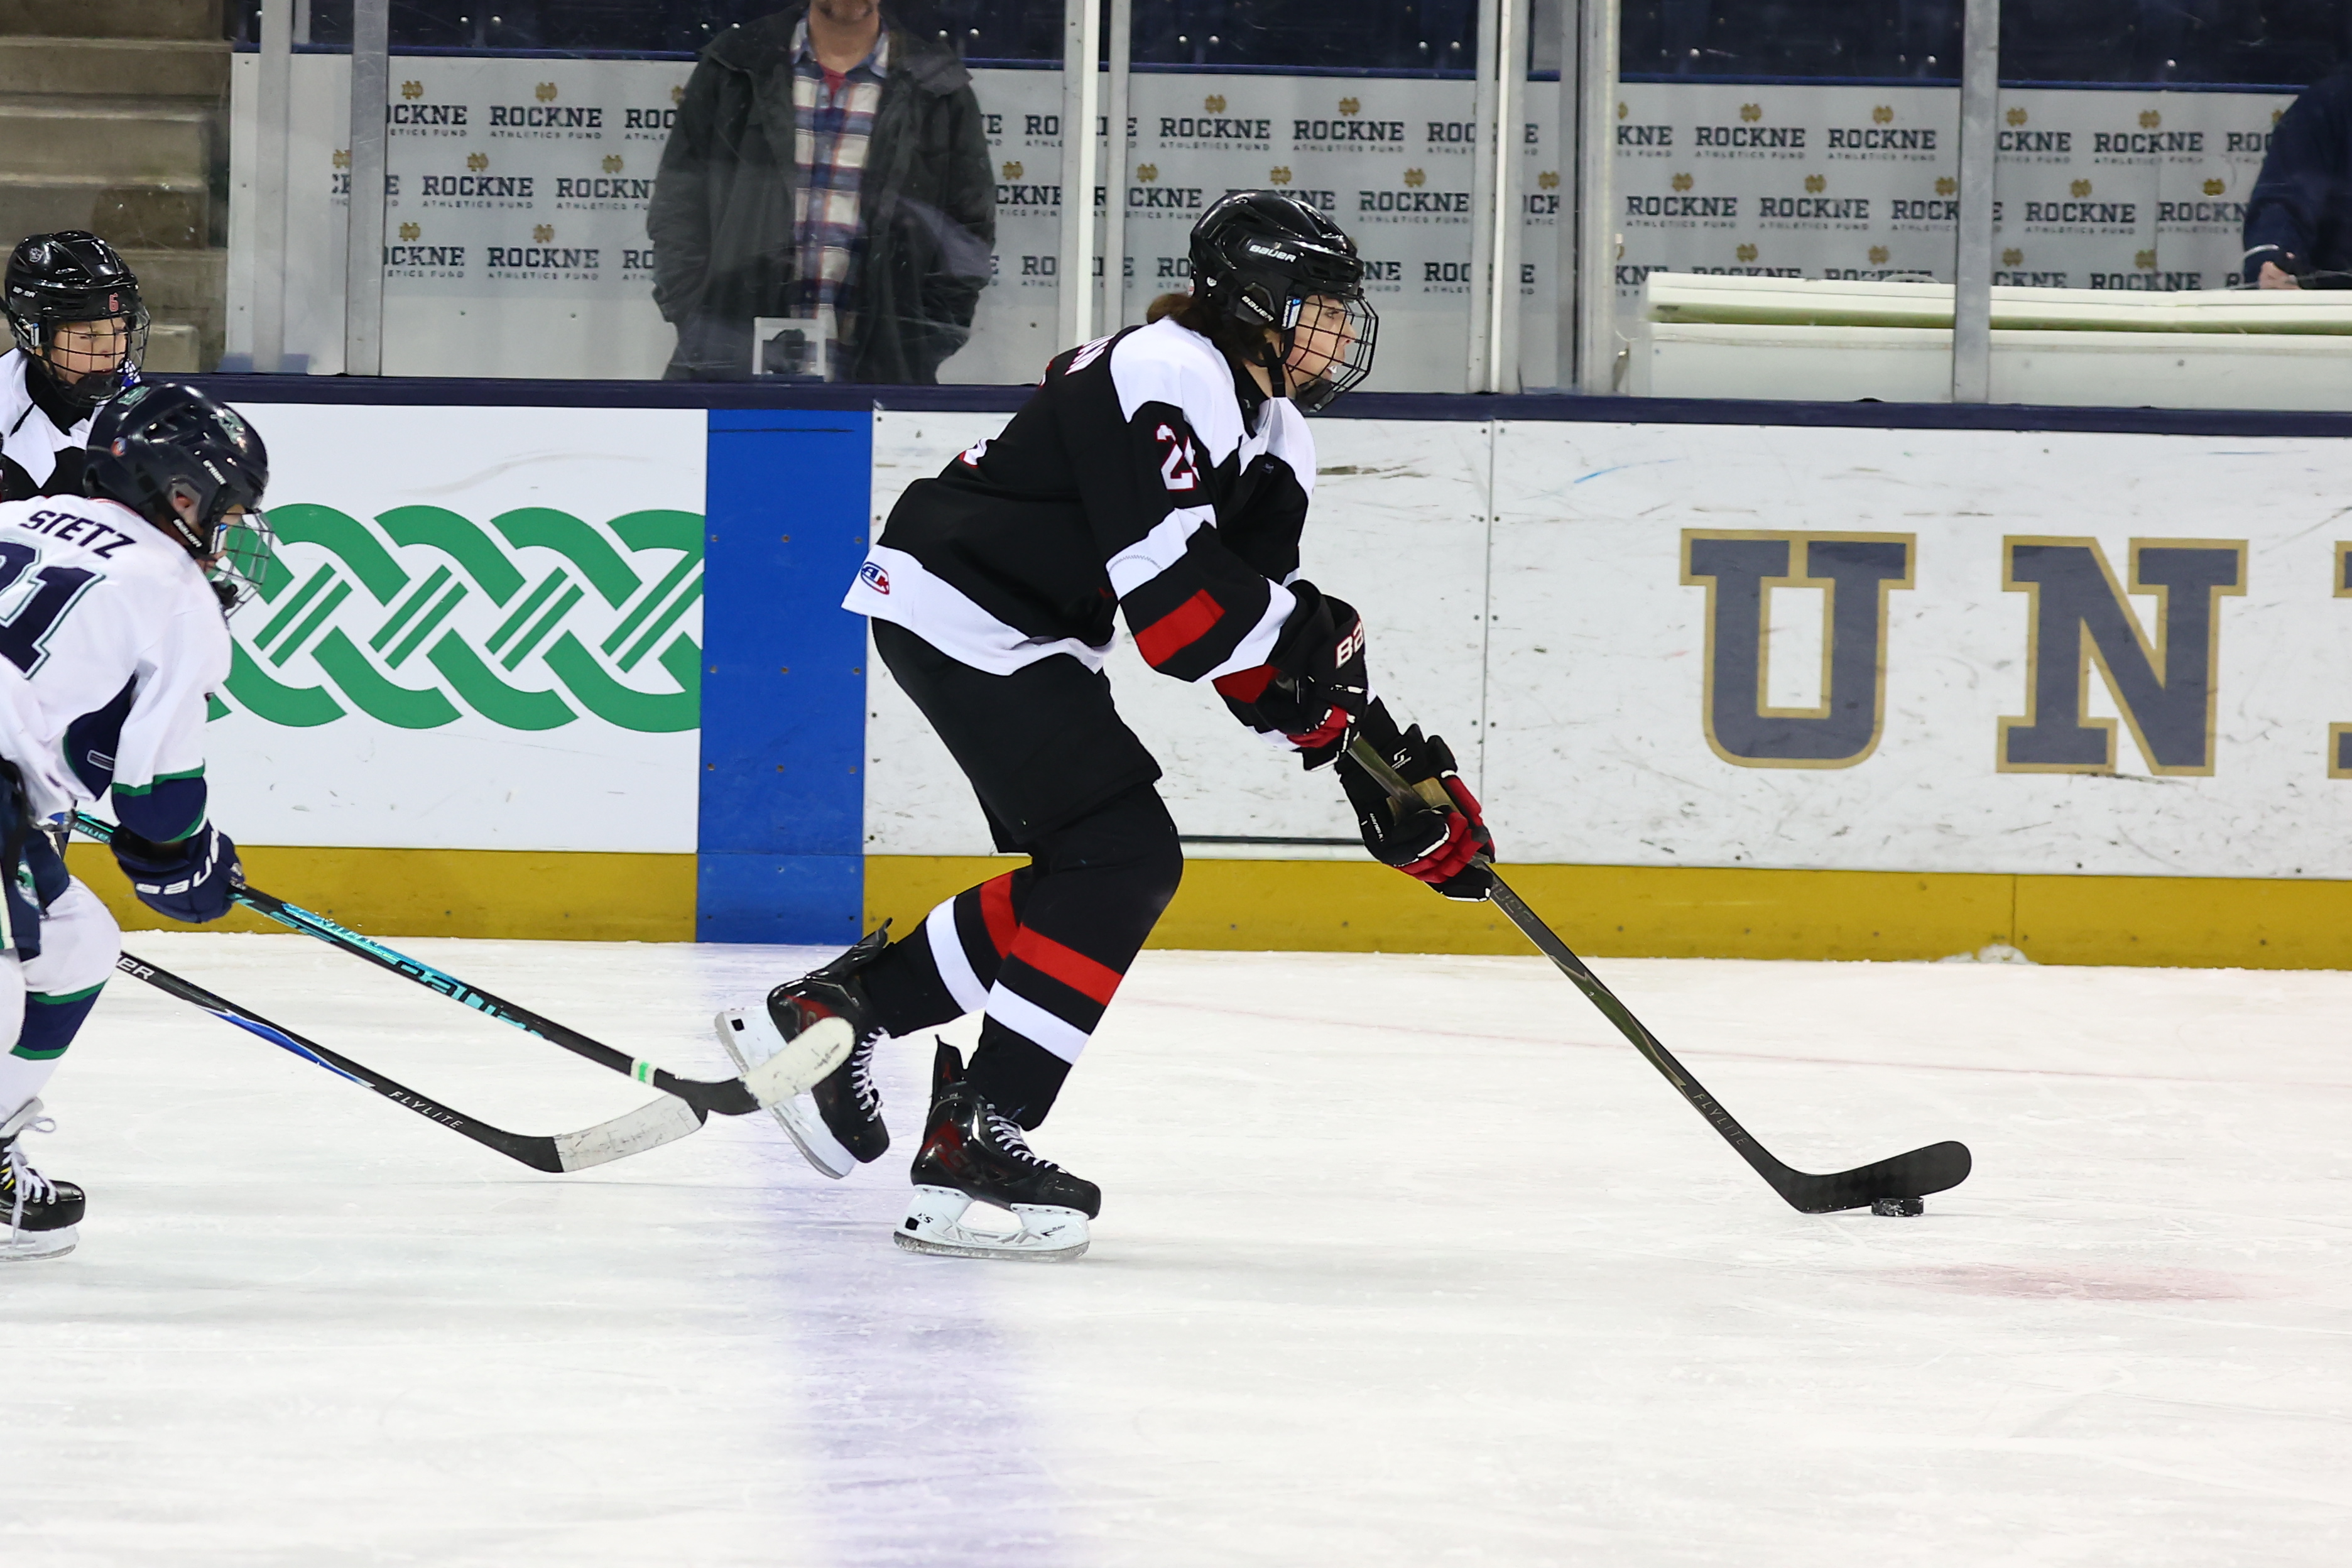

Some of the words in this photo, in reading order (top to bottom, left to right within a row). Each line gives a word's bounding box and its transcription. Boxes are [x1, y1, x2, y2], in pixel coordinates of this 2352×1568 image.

[388, 105, 467, 126] CKNE
[489, 106, 602, 128] ROCKNE
[1159, 117, 1271, 139] ROCKNE
[1293, 120, 1404, 141] ROCKNE
[1695, 126, 1805, 148] ROCKNE
[1828, 129, 1937, 150] ROCKNE
[2000, 131, 2071, 151] CKNE
[2094, 131, 2204, 153] ROCKNE
[422, 176, 533, 197] ROCKNE
[557, 178, 655, 198] ROCKN
[1359, 191, 1469, 212] ROCKNE
[1626, 196, 1738, 217] ROCKNE
[1759, 197, 1870, 219] ROCKNE
[2025, 202, 2136, 224] ROCKNE
[384, 246, 464, 266] CKNE
[487, 247, 599, 268] ROCKNE
[1249, 244, 1297, 262] BAUER
[1241, 296, 1274, 322] BAUER
[18, 510, 137, 560] STETZ
[388, 1091, 464, 1128] FLYLITE
[1693, 1094, 1750, 1146] FLYLITE
